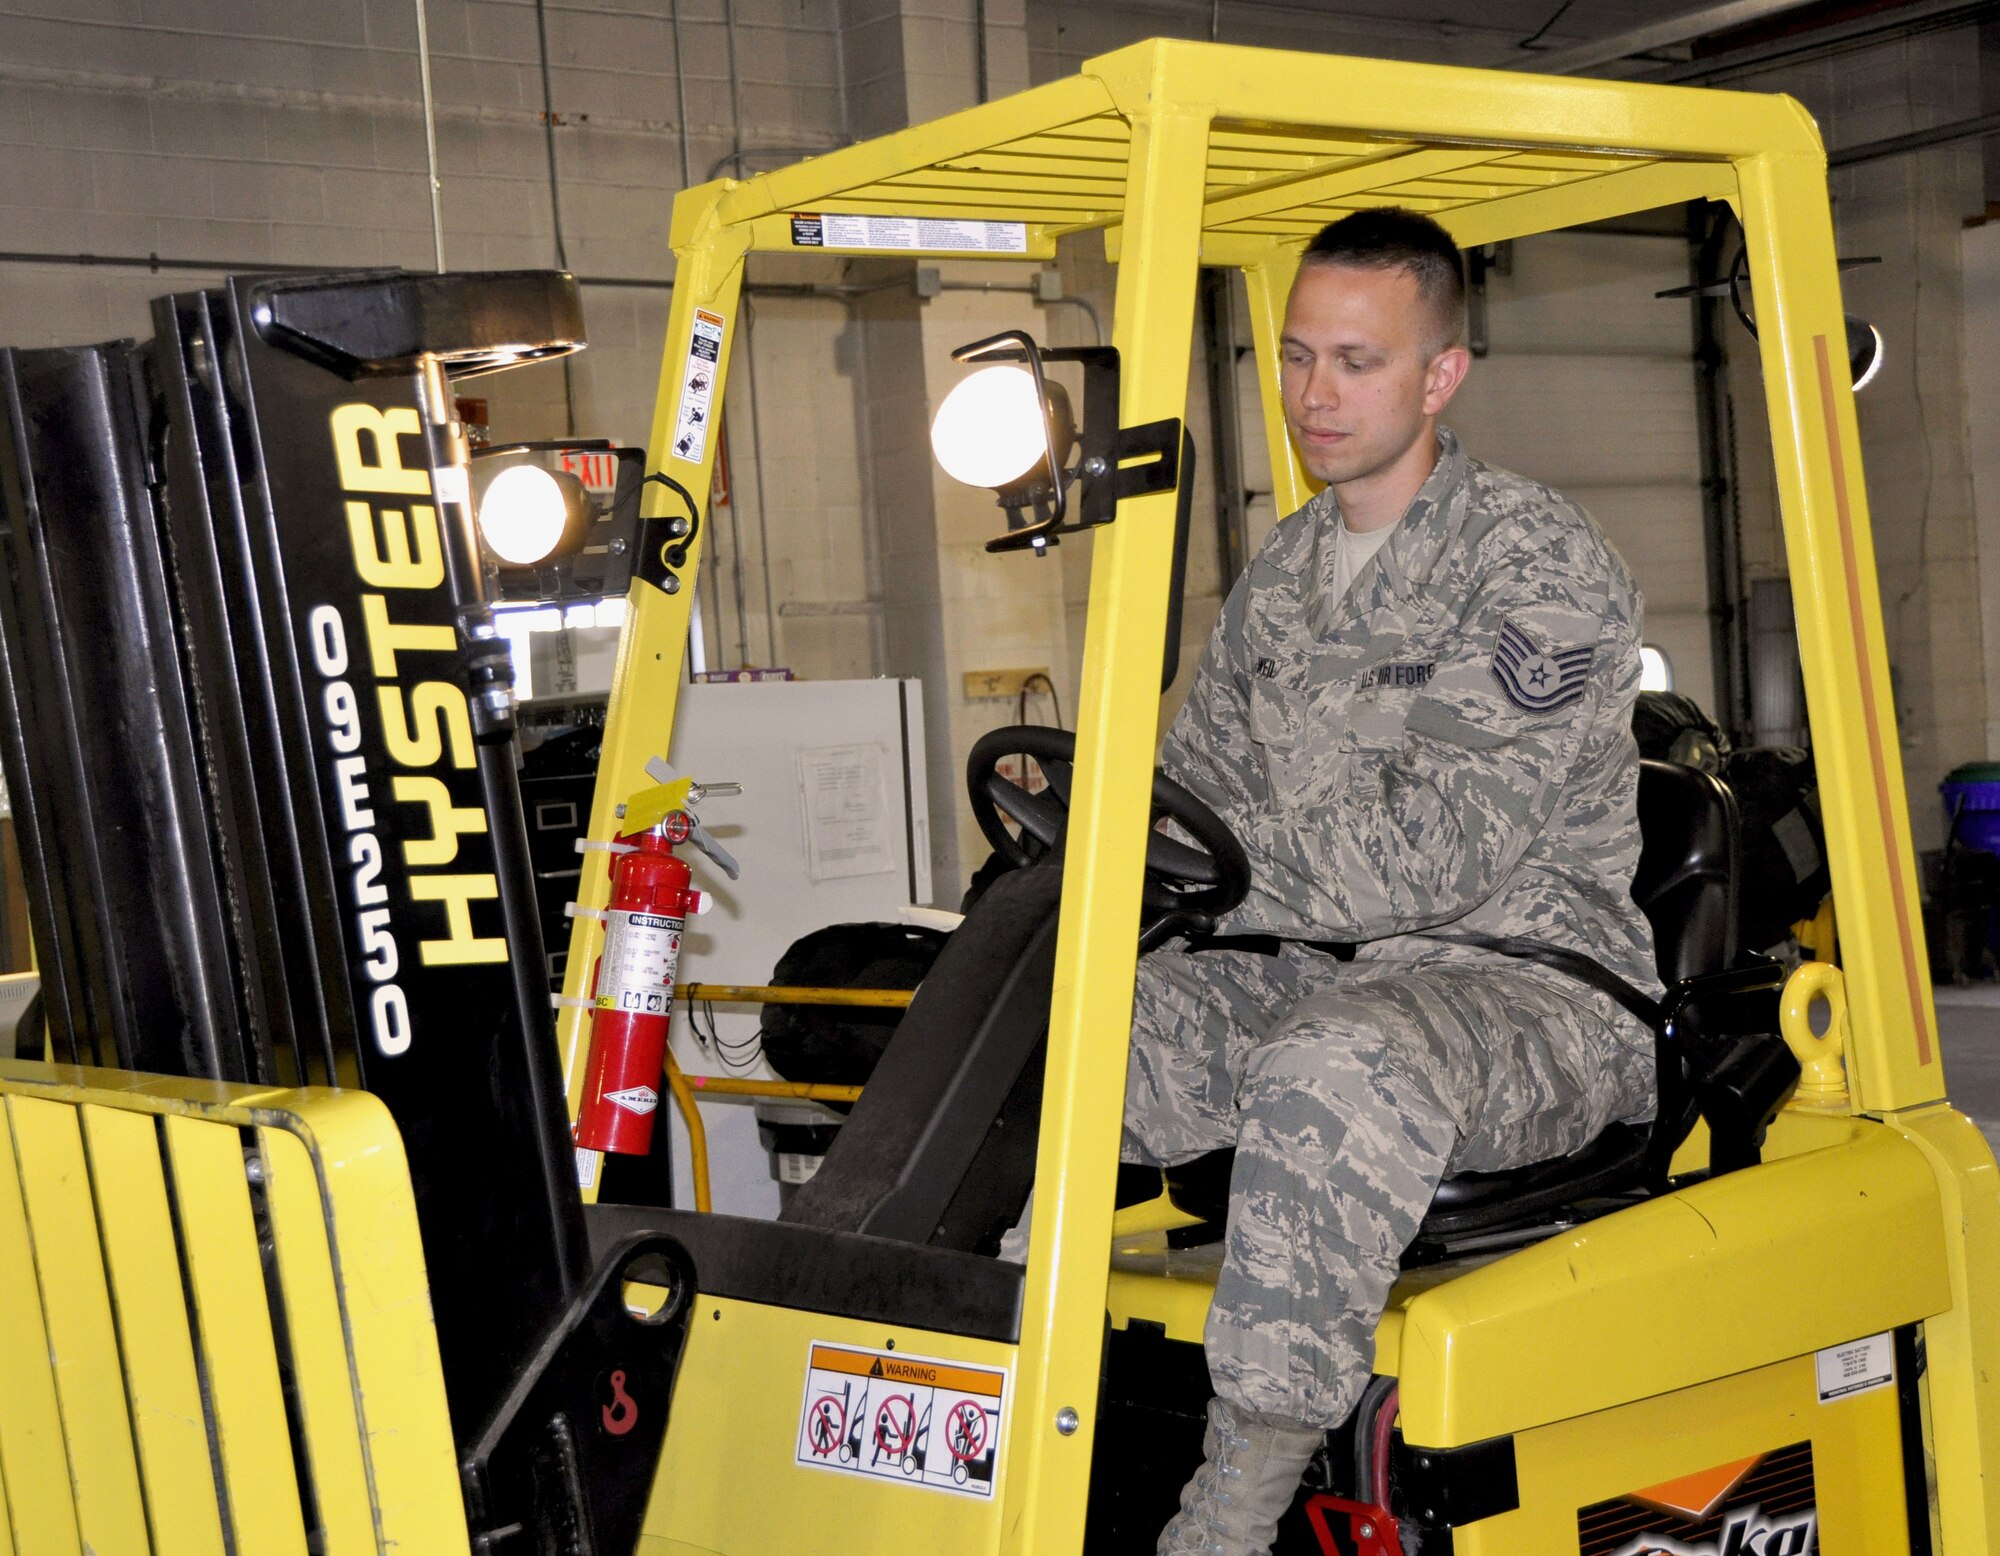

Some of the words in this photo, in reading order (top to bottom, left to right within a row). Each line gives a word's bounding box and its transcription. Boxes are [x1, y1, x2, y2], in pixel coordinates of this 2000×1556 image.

[330, 403, 508, 966] HYSTER
[1395, 663, 1434, 685] FORC
[310, 604, 412, 1057] 09E250
[631, 915, 684, 930] INSTRUCTIO
[886, 1362, 937, 1382] WARNING
